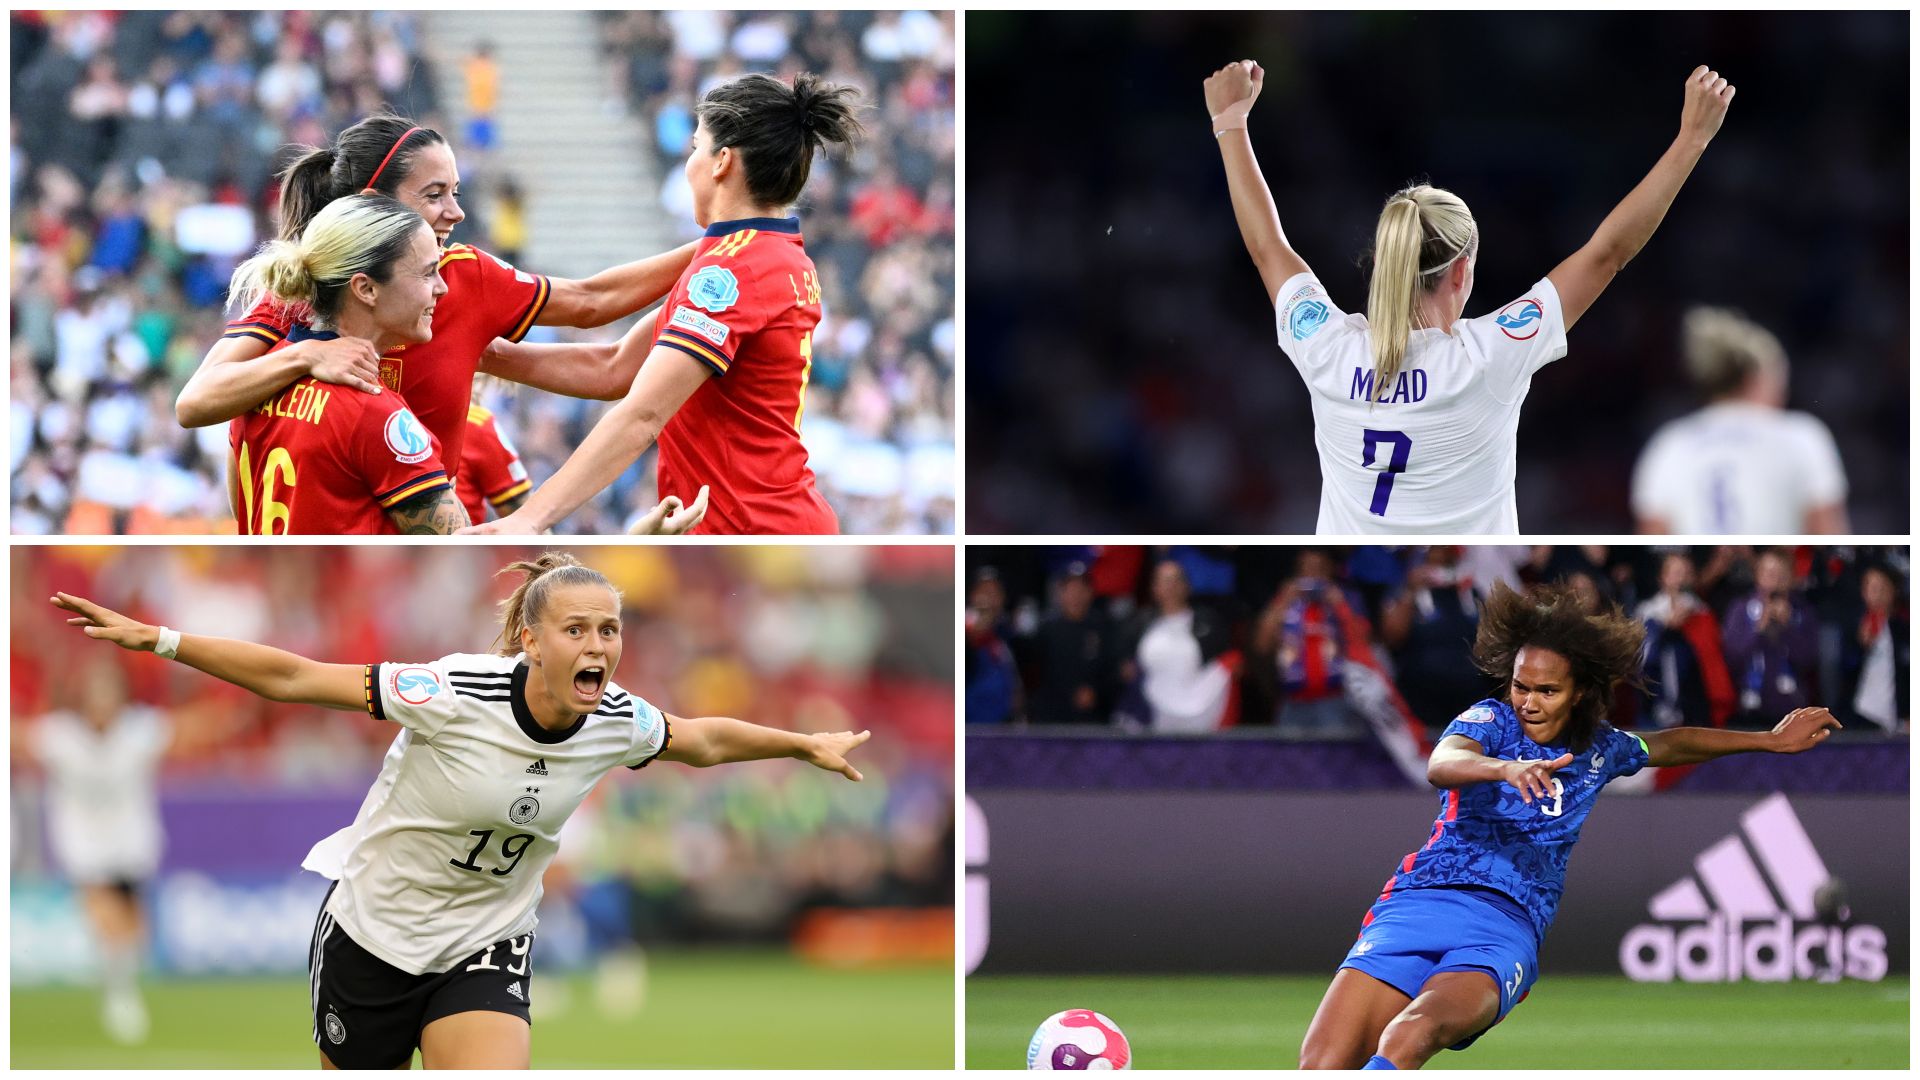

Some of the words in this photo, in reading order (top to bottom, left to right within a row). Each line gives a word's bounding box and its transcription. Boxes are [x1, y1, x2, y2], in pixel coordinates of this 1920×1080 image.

[239, 441, 296, 535] 16
[1361, 429, 1413, 517] 7
[526, 767, 549, 776] adidas
[1541, 778, 1565, 817] 3
[449, 829, 536, 876] 19
[466, 936, 531, 976] 19
[1619, 912, 1889, 983] adidas
